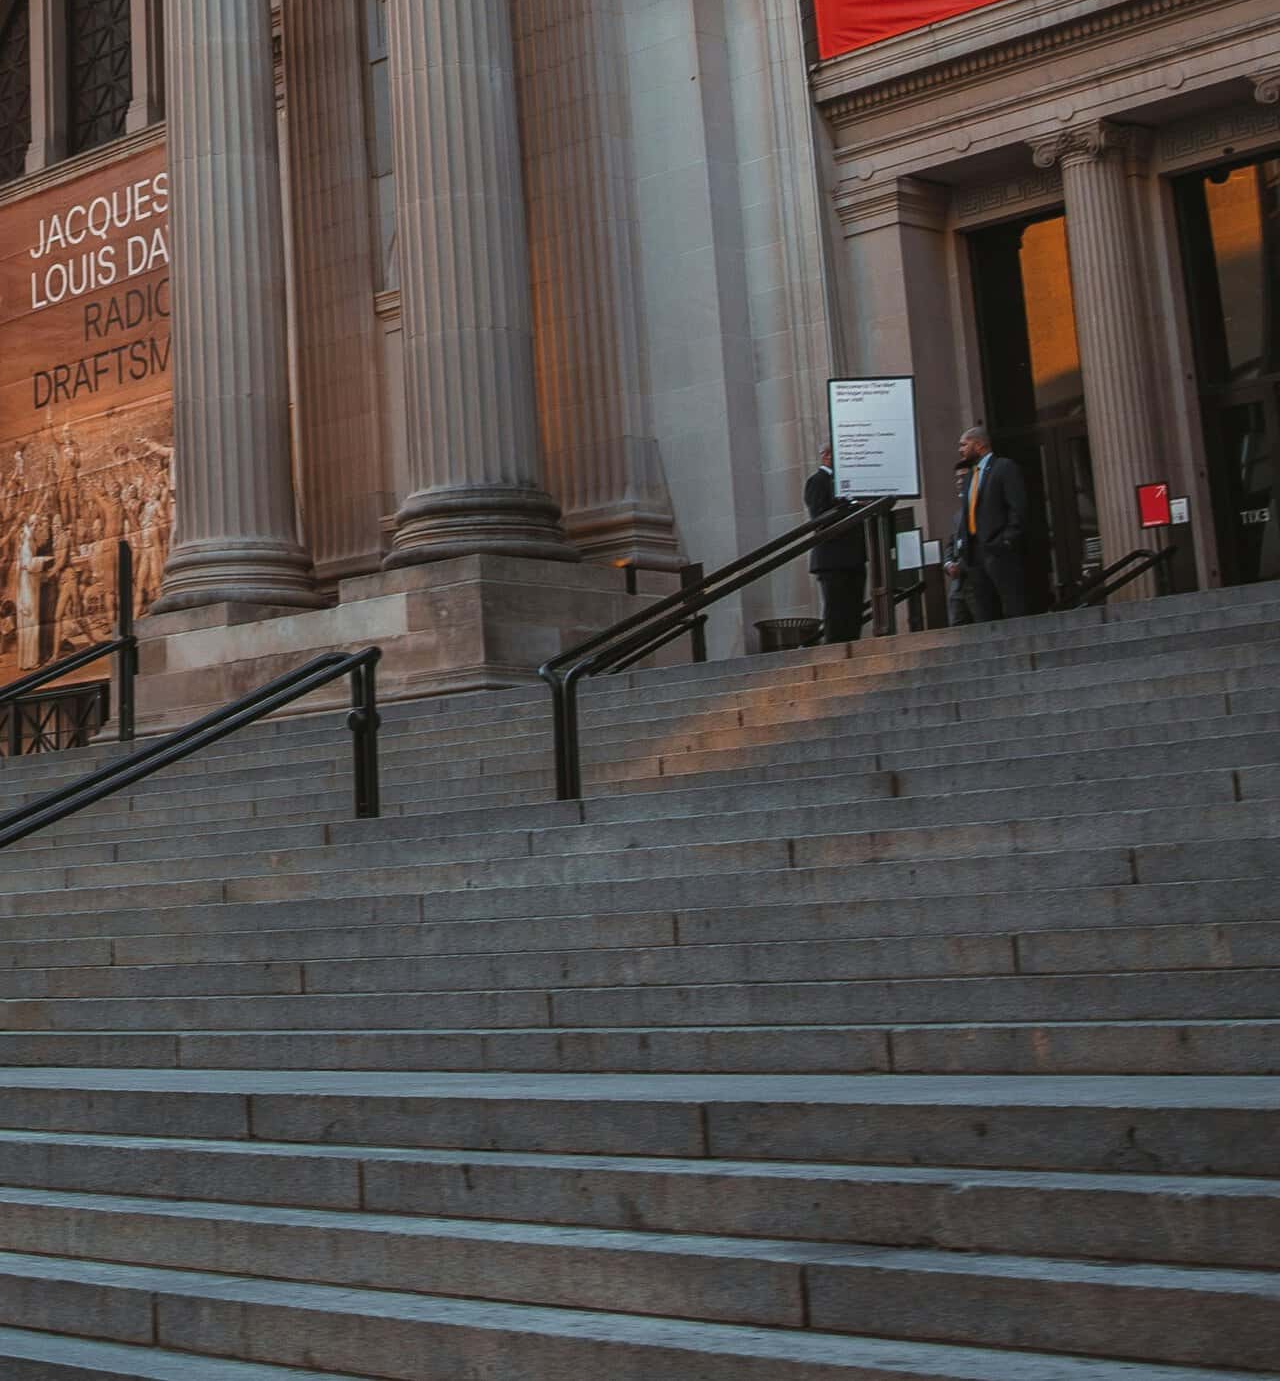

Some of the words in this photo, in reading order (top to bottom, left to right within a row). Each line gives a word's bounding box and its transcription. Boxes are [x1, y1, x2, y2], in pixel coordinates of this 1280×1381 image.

[29, 172, 168, 259] JACQUES
[31, 245, 117, 310] LOUIS
[127, 224, 170, 277] DA
